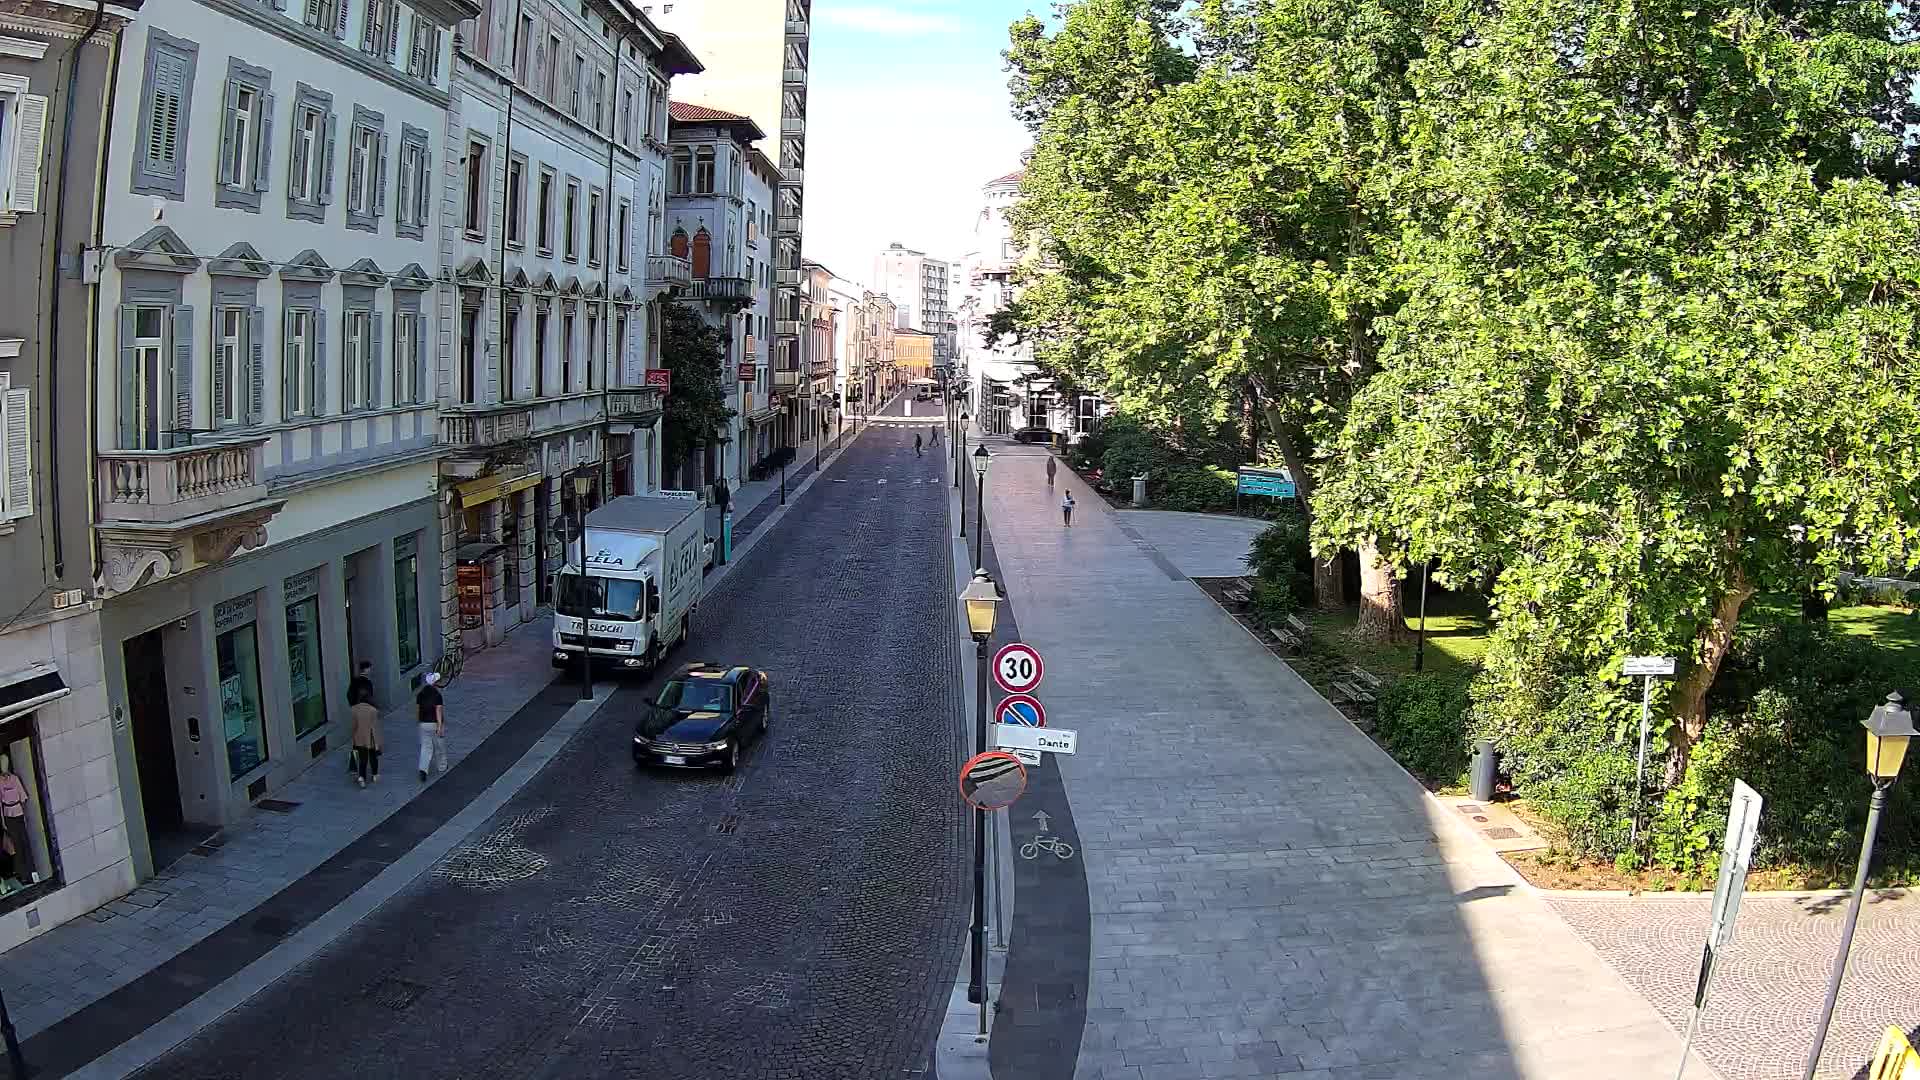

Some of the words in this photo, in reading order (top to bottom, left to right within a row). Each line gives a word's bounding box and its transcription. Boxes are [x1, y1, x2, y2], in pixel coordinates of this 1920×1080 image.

[585, 555, 623, 566] CELA
[571, 621, 624, 634] TRSLOCHI
[1005, 657, 1032, 680] 30
[1038, 737, 1069, 749] Dante
